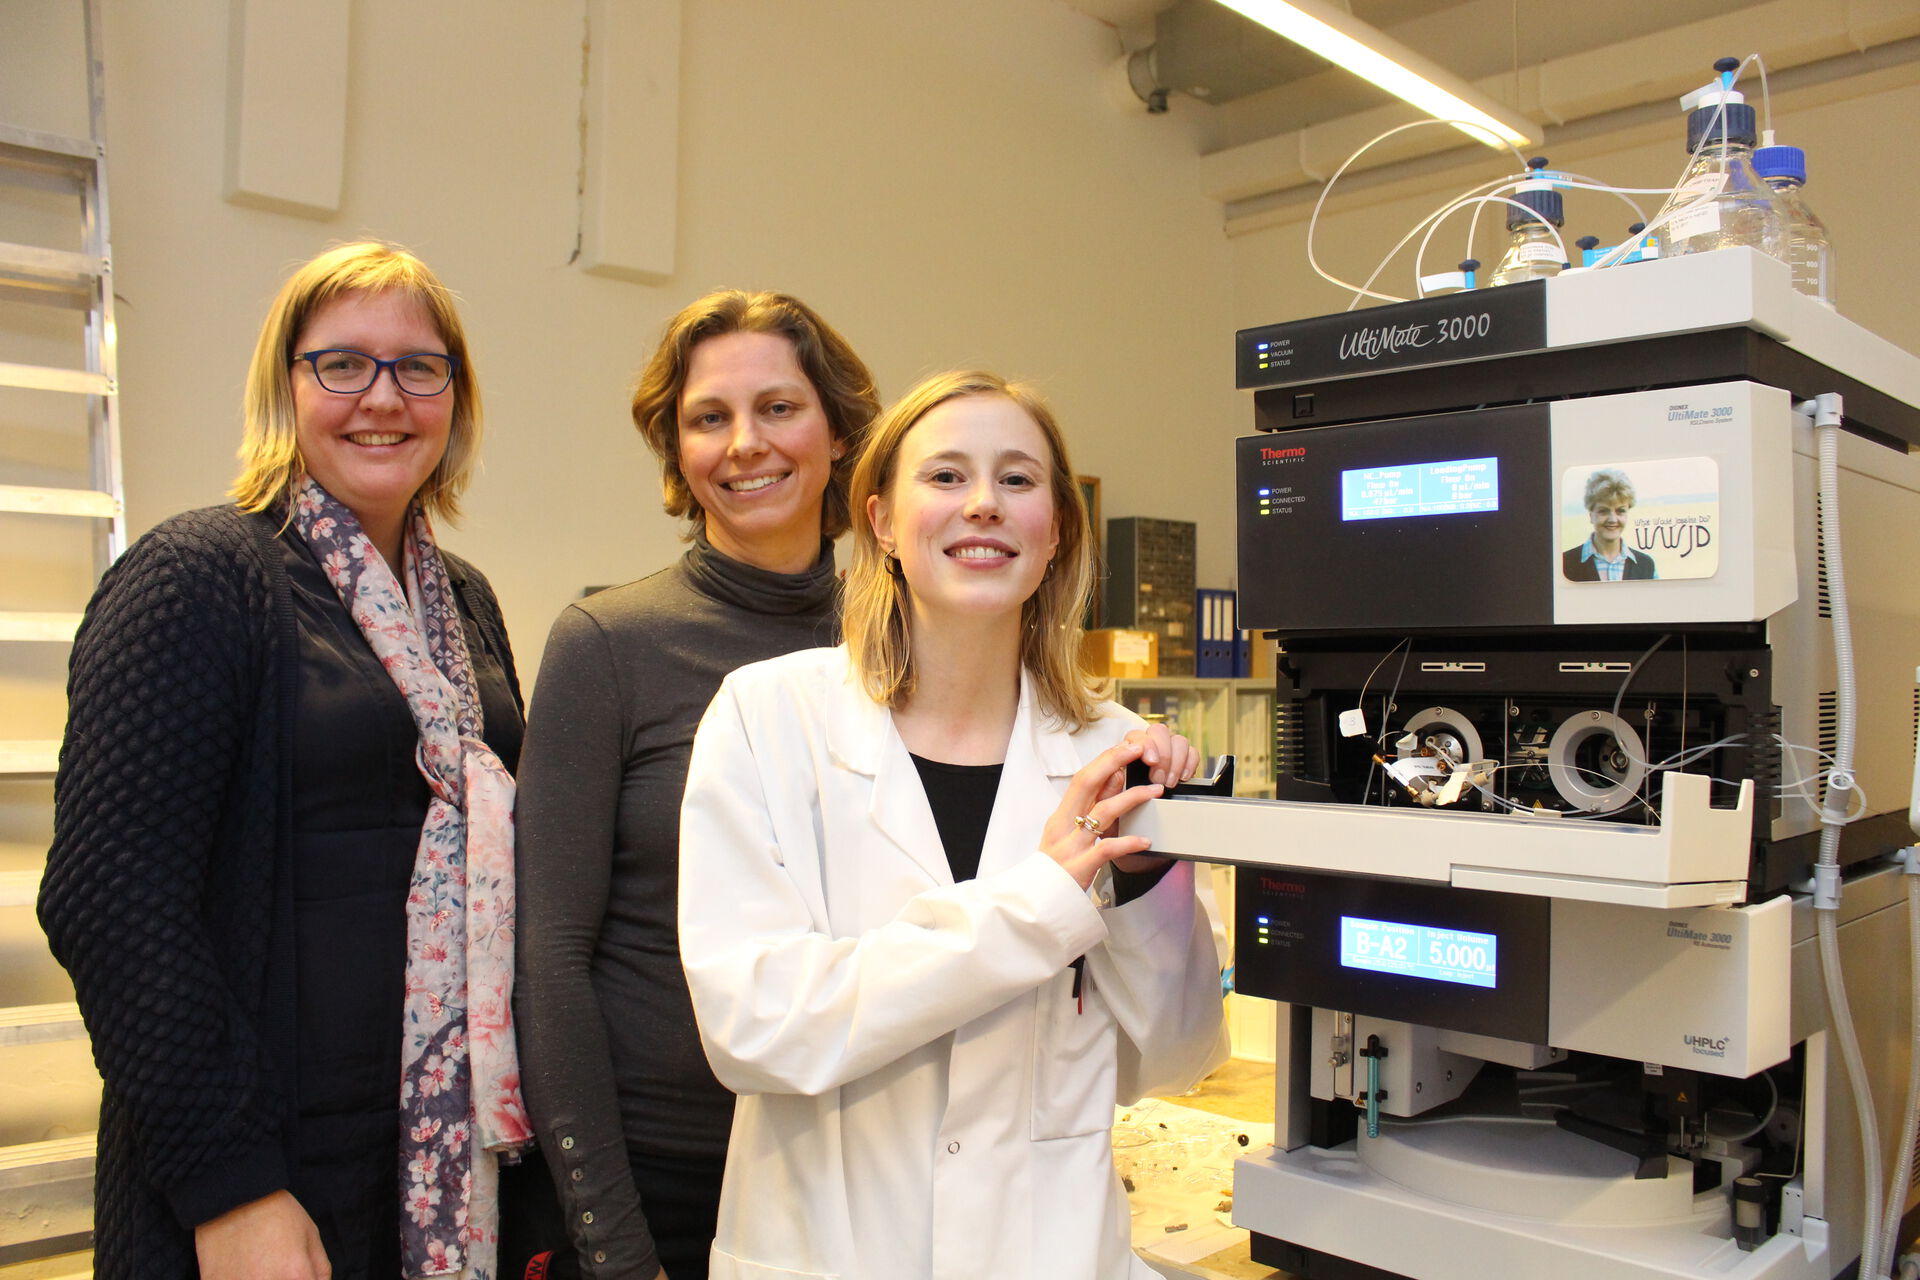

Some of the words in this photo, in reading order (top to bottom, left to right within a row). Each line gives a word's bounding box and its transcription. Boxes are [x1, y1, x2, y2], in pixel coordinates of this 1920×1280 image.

[1340, 323, 1435, 360] UltiMate
[1437, 312, 1490, 344] 3000
[1270, 339, 1290, 348] POWER
[1270, 349, 1294, 357] VACUUM
[1270, 359, 1290, 368] STATUS
[1667, 410, 1709, 421] UltiMate
[1711, 406, 1733, 417] 3000
[1260, 447, 1306, 460] Thermo
[1262, 457, 1305, 466] SCIENTIFIC
[1272, 487, 1292, 495] POWER
[1272, 496, 1306, 504] CONNECTED
[1261, 877, 1305, 893] Thermo
[1667, 927, 1708, 941] UltiMate
[1356, 931, 1408, 960] B-A2
[1429, 940, 1486, 970] 5.000
